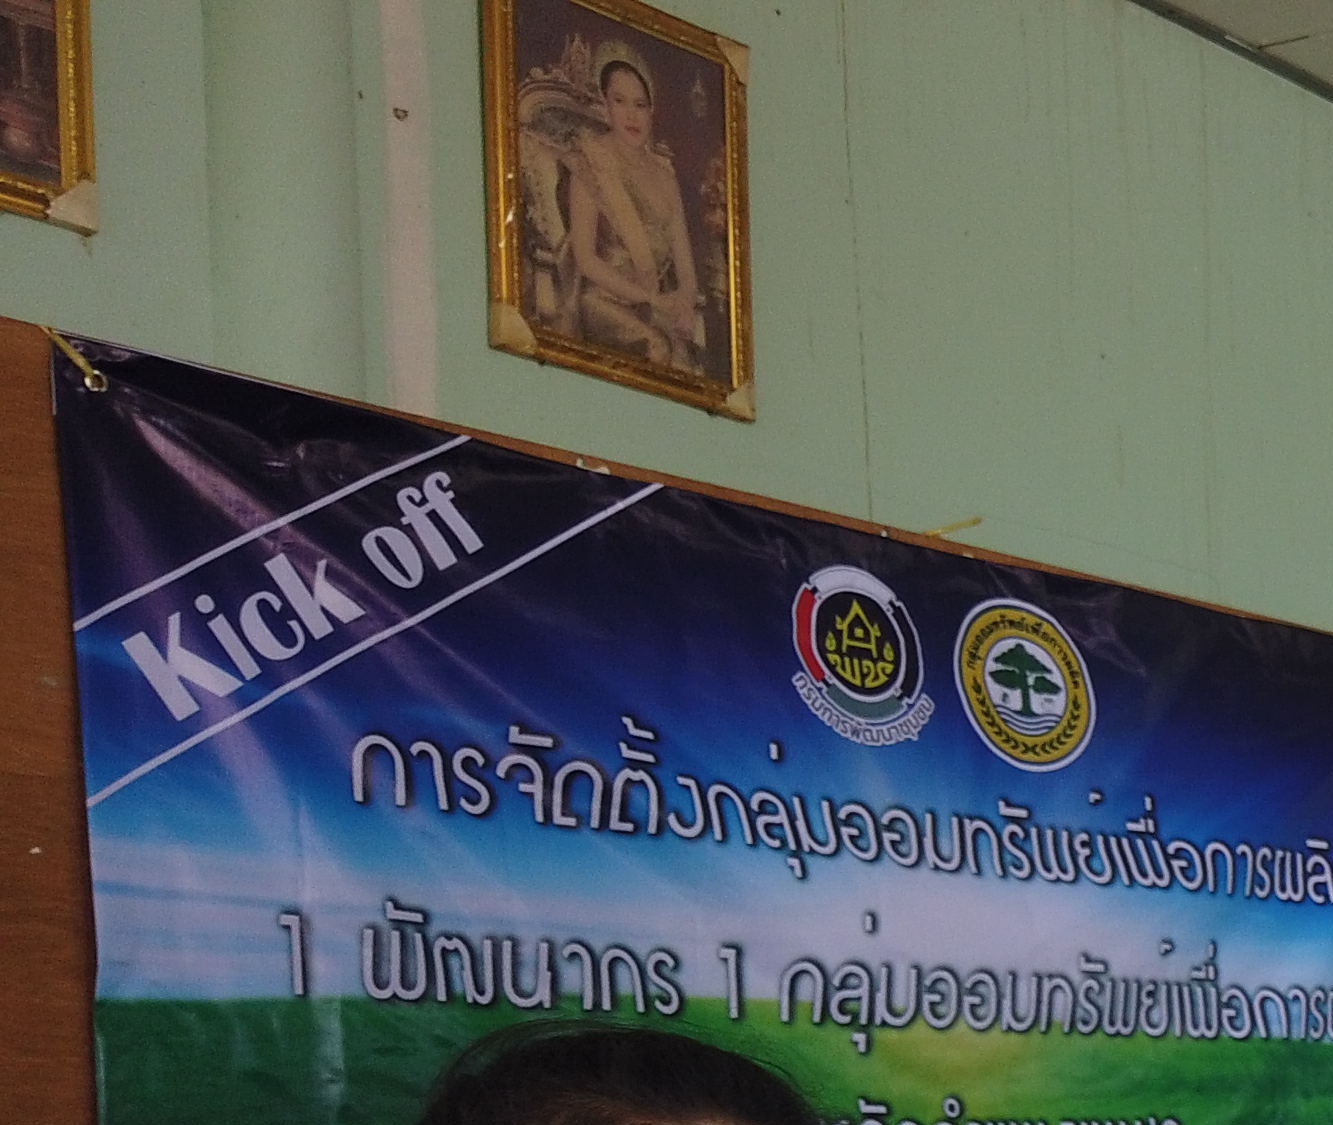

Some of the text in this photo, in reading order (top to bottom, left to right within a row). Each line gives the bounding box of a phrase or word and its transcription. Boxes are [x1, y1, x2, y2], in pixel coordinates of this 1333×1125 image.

[121, 471, 484, 721] Kick off
[794, 673, 935, 744] กรมการพัฒนาชุมชน
[279, 912, 305, 997] 1
[361, 900, 682, 1015] พัฒนากร
[719, 946, 742, 1019] 1
